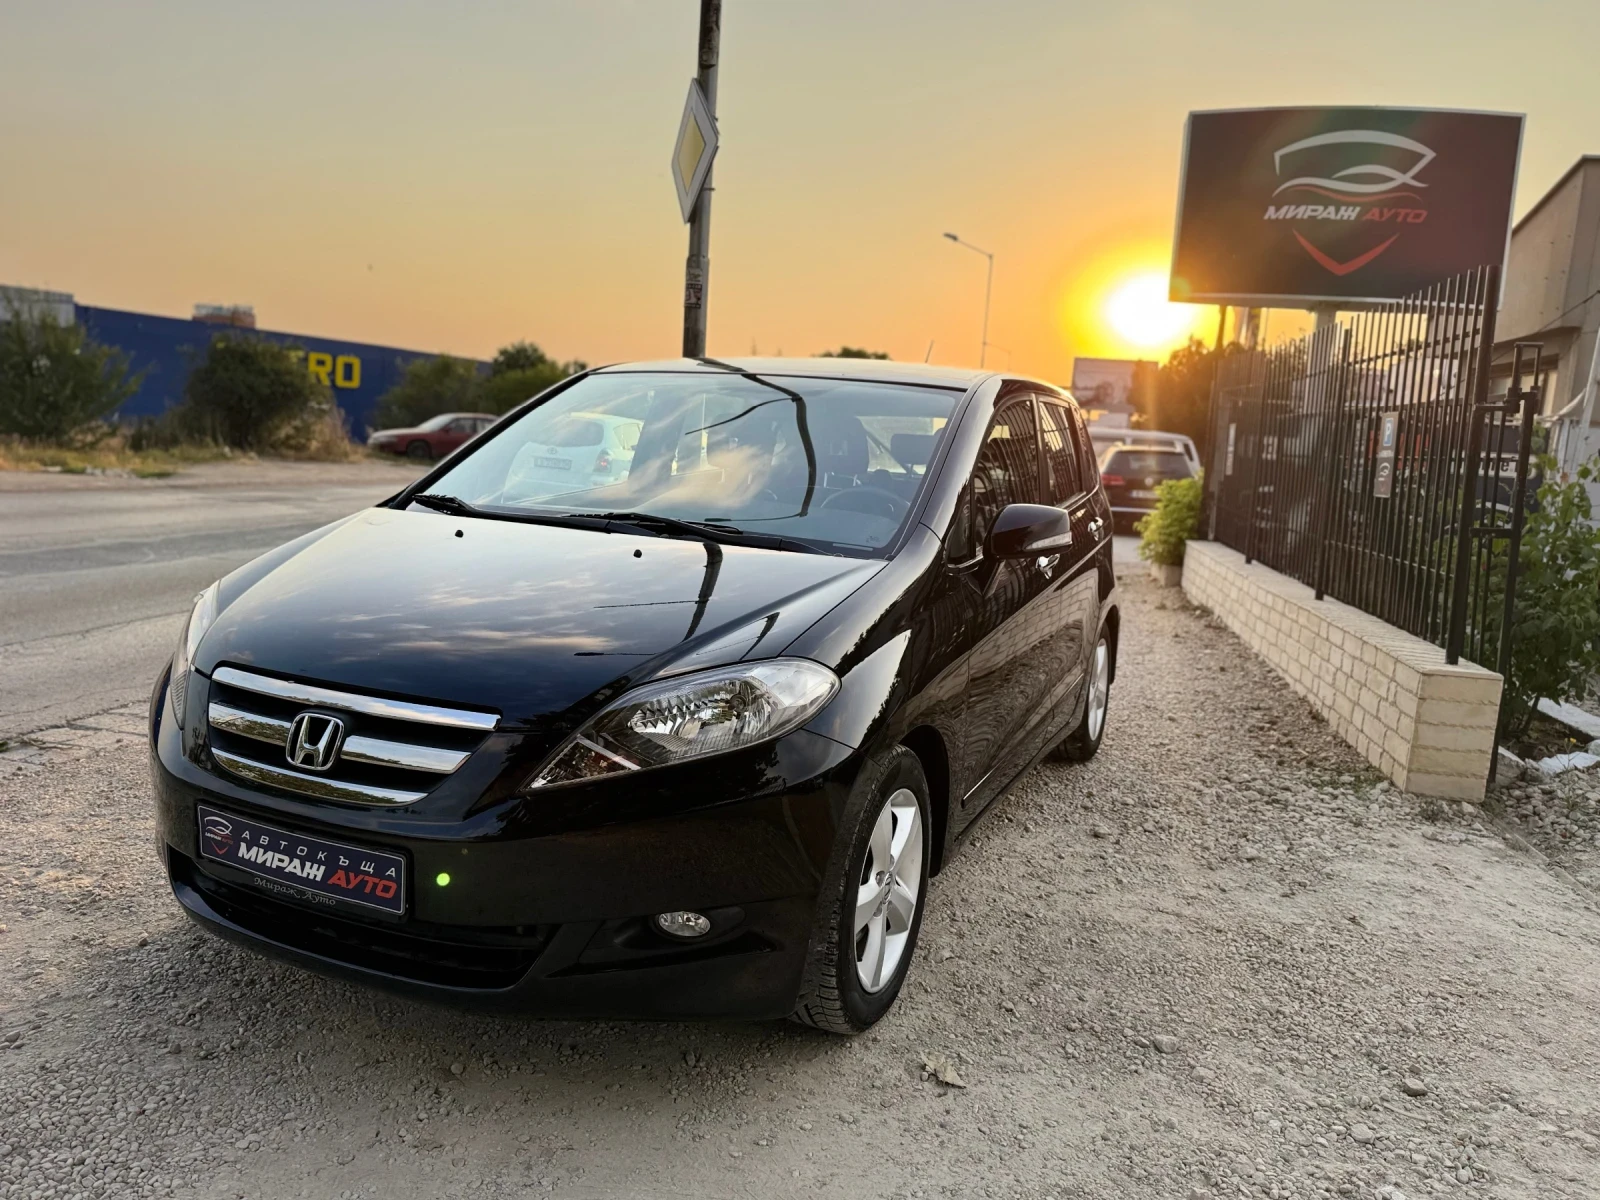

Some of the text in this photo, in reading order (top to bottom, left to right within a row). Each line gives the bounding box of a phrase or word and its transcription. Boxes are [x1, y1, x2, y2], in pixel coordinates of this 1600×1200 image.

[1263, 205, 1428, 223] МИРАЖ АУТО
[237, 841, 398, 899] МИРАЖ АУТО
[241, 830, 397, 878] АВТОКЪЩА
